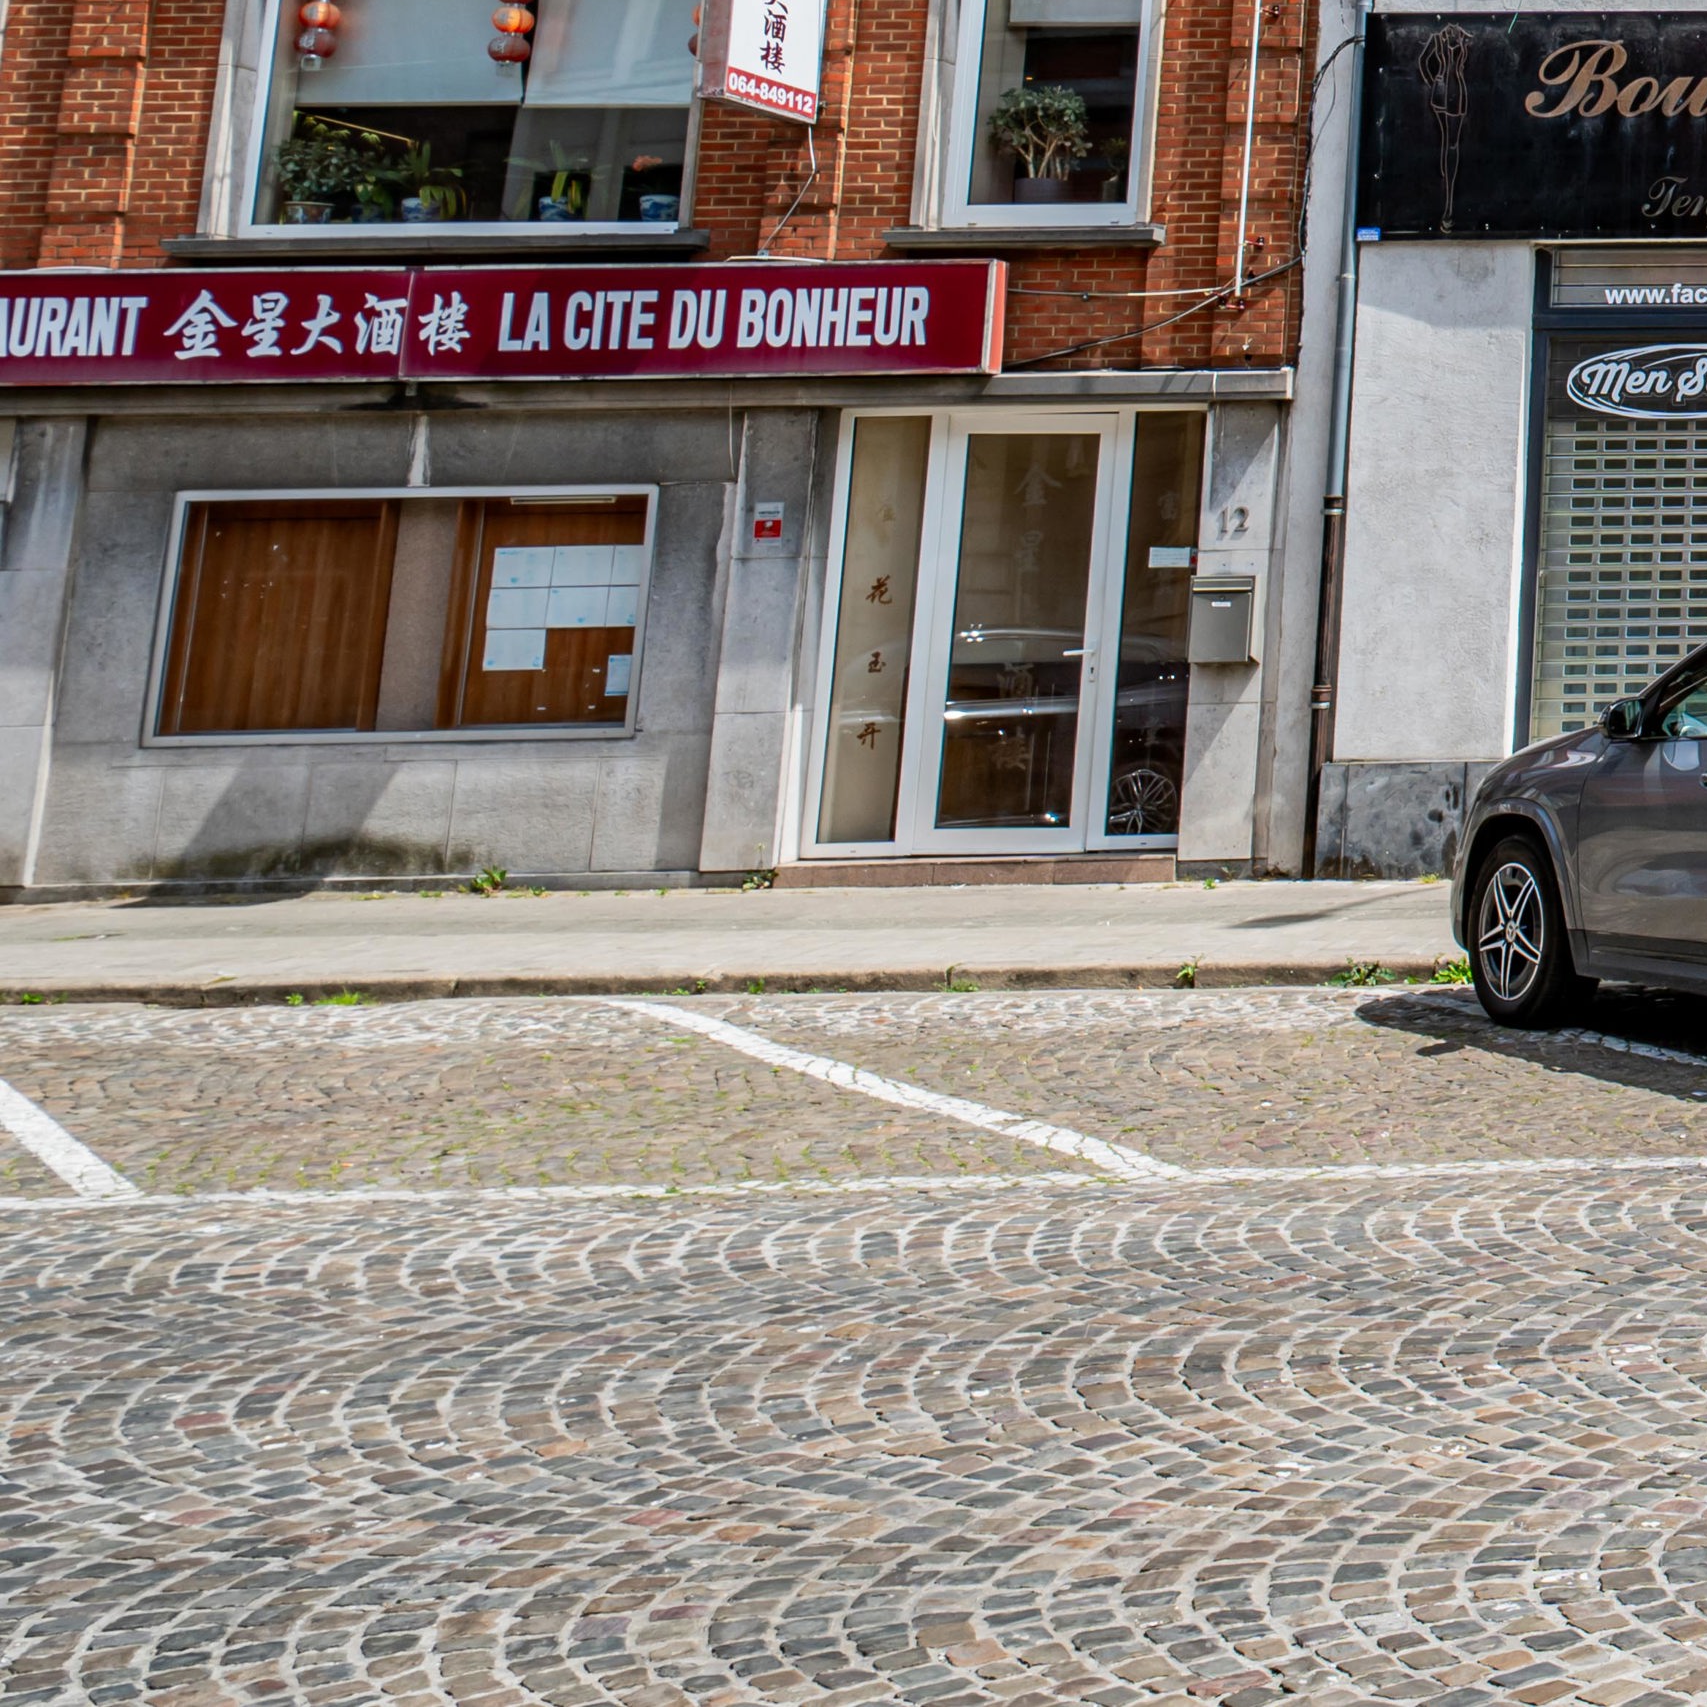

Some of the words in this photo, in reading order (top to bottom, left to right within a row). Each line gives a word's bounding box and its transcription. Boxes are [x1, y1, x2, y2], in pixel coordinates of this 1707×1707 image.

[728, 72, 814, 114] 064-849112
[163, 289, 471, 360] 金星大酒楼
[497, 292, 550, 352] LA
[563, 290, 660, 351] CITE
[667, 289, 727, 350] DU
[737, 286, 930, 348] BONHEUR
[1580, 361, 1672, 398] Men
[1219, 506, 1250, 534] 12
